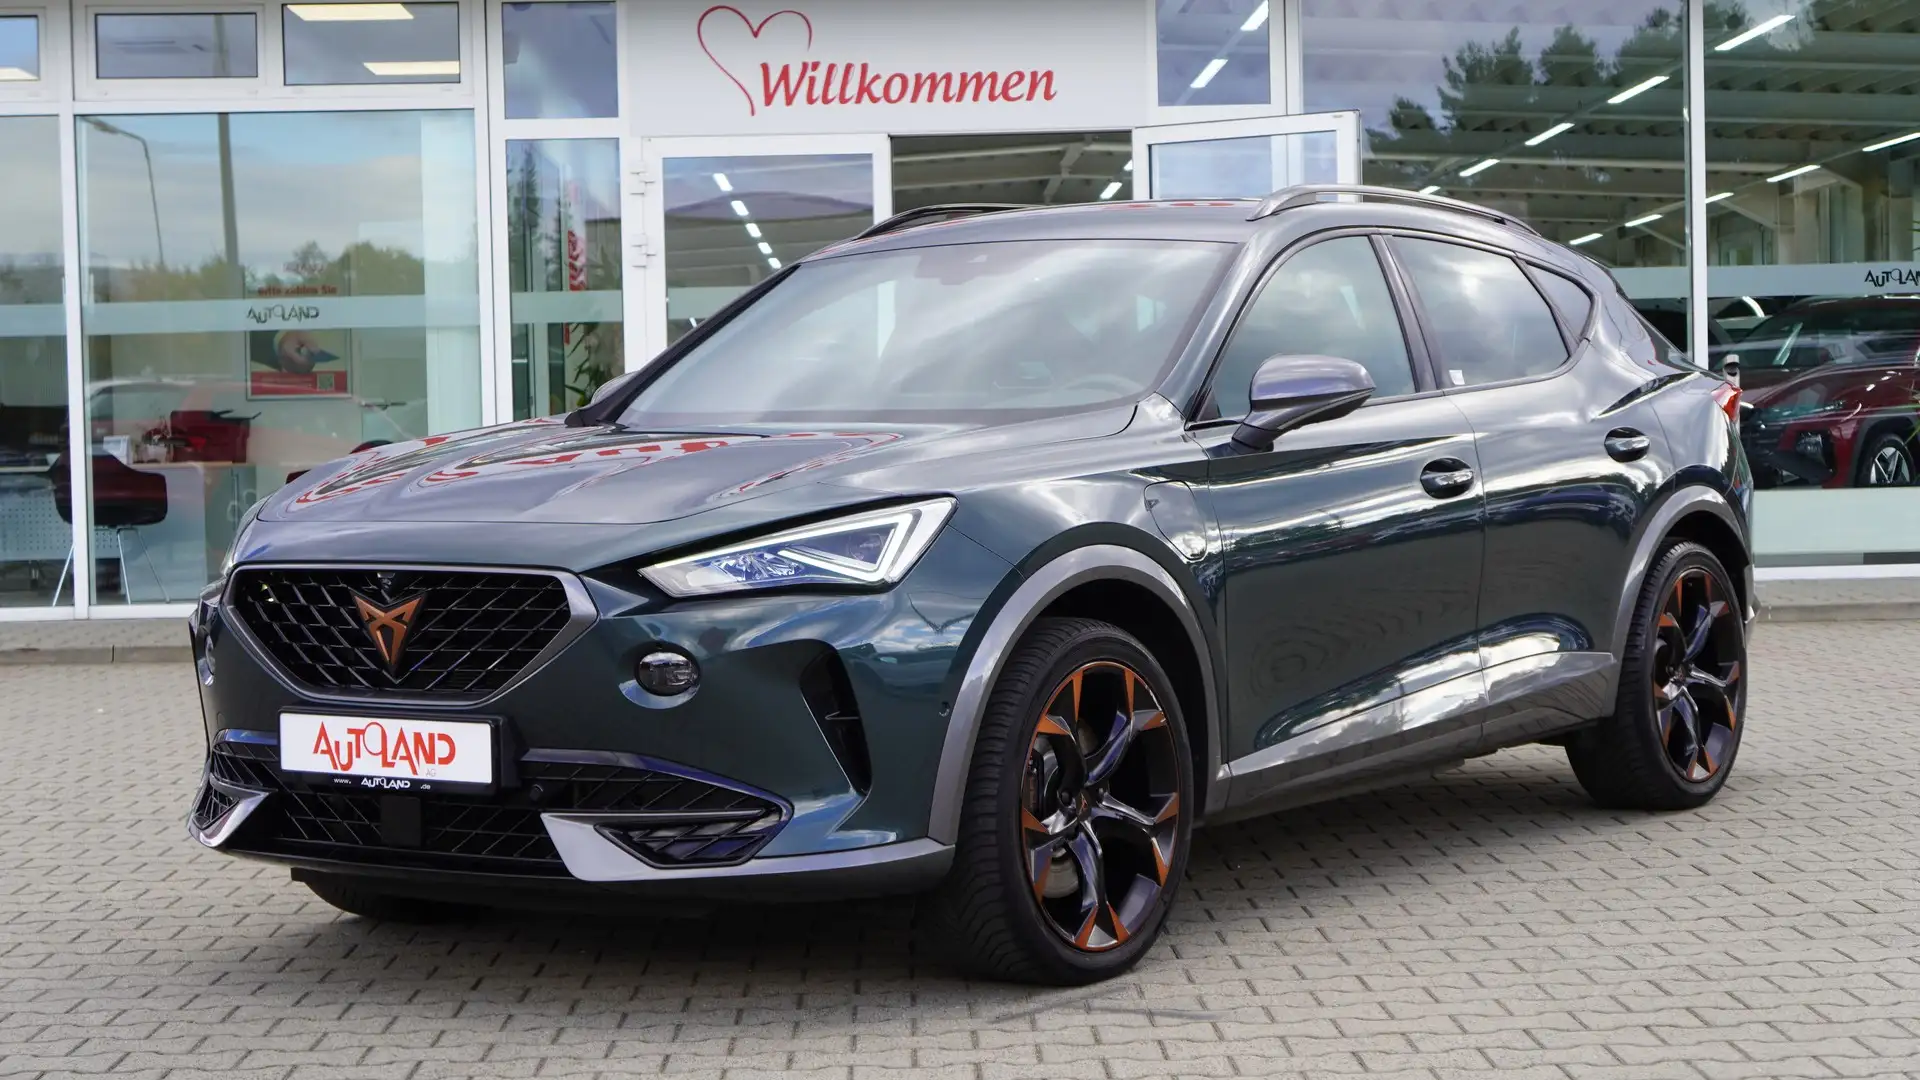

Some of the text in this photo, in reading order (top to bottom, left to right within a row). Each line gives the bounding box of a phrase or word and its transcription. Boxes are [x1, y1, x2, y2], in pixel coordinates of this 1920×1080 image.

[760, 61, 1057, 107] Willkommen
[247, 304, 320, 324] AUTOLAND
[313, 721, 456, 776] AUTOLAND
[360, 777, 411, 790] AUTOLAND
